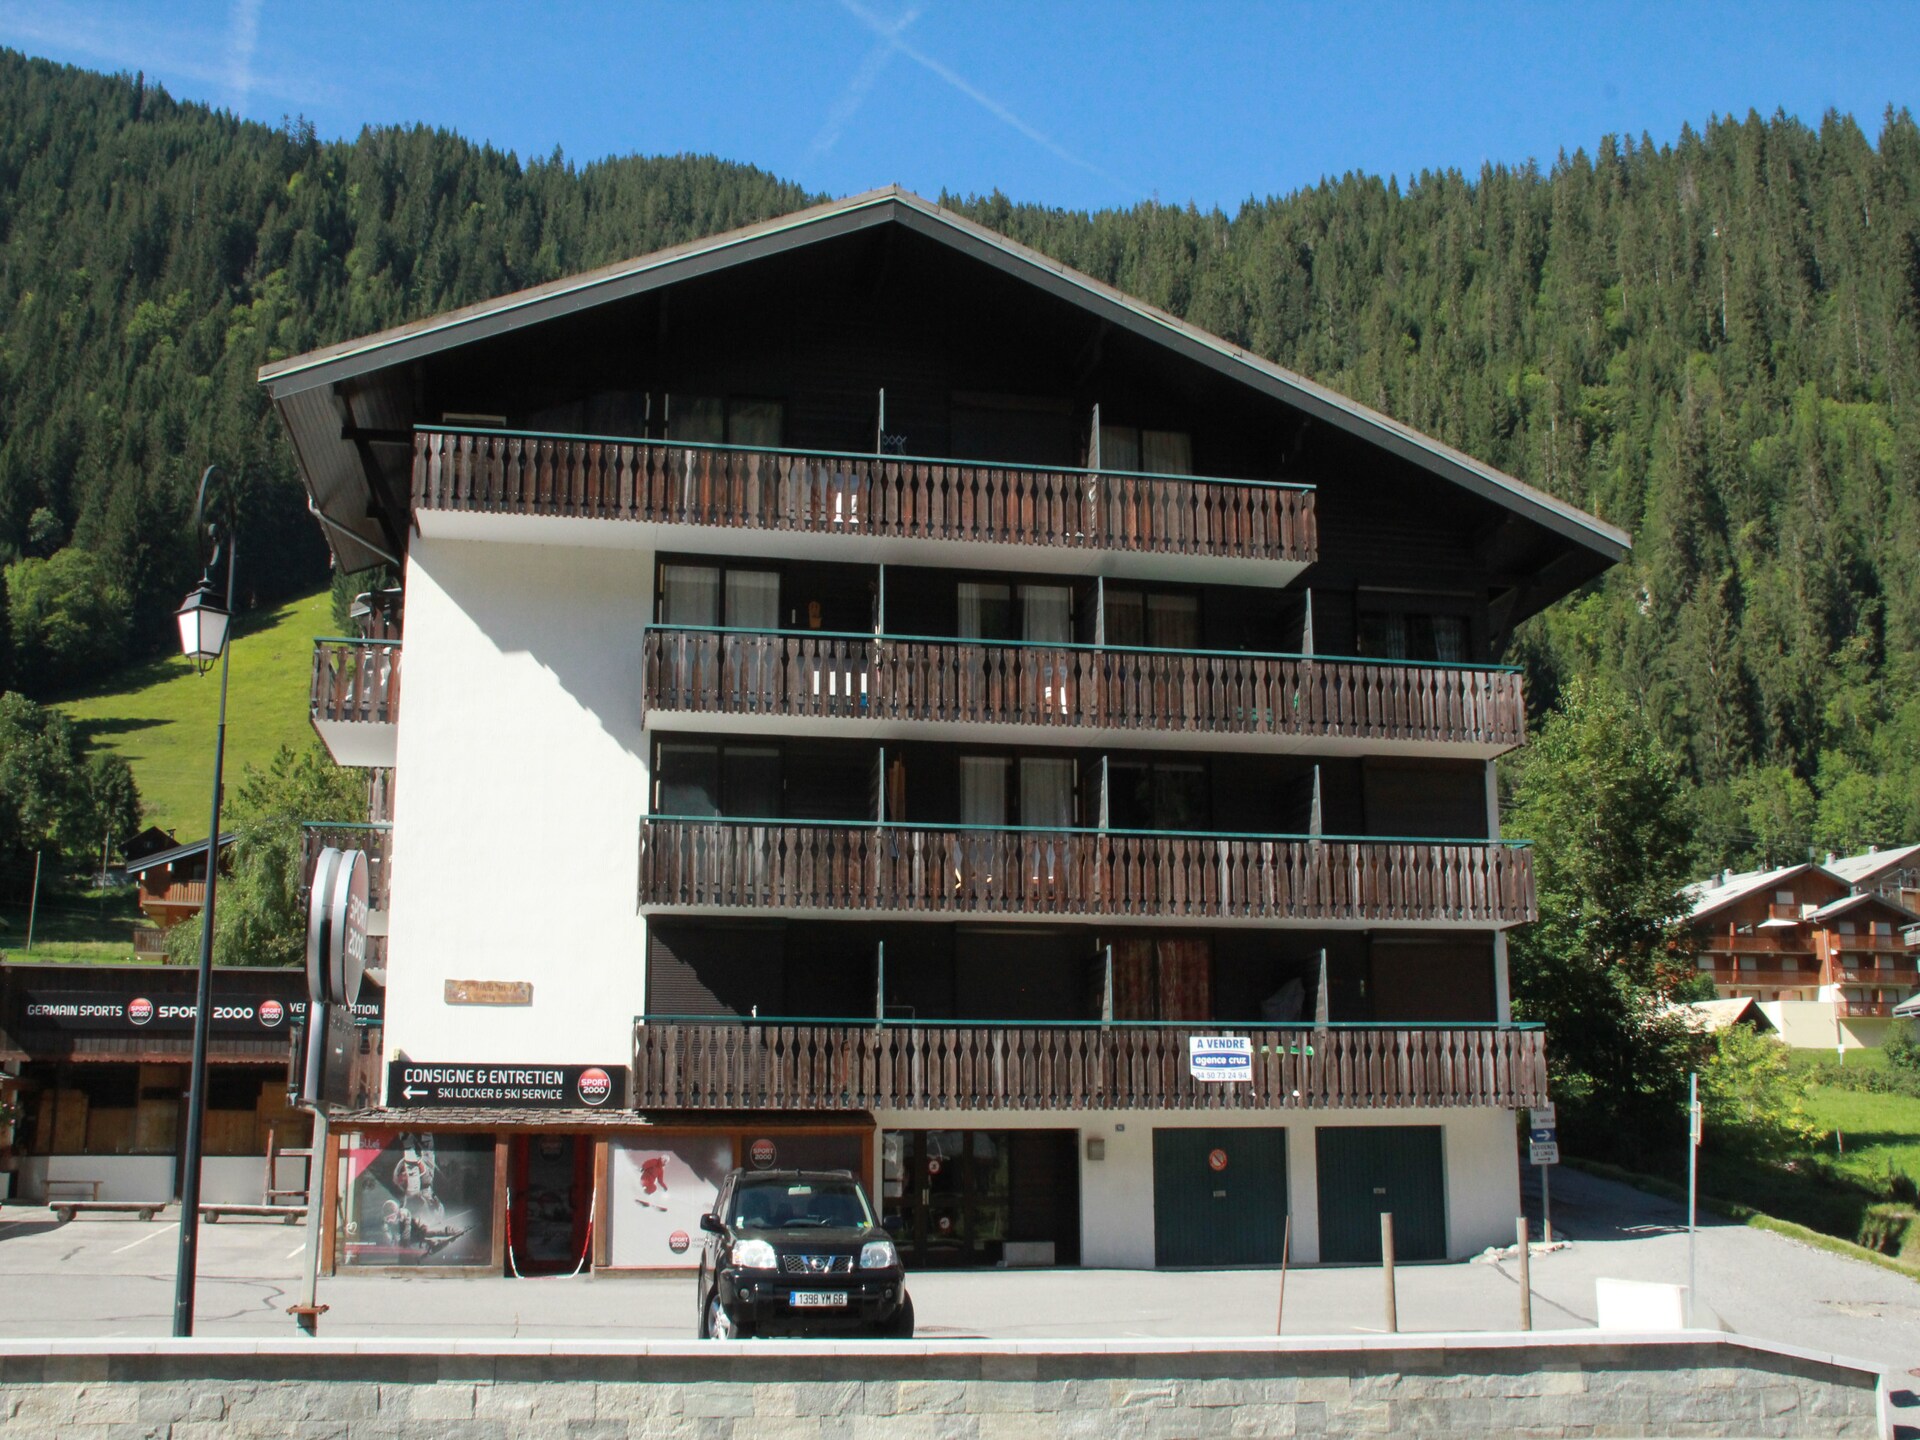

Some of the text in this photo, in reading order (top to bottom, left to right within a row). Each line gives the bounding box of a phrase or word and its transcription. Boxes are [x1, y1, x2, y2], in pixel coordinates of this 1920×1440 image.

[348, 928, 364, 960] 2000
[27, 1004, 123, 1016] GERMAIN SPORTS
[158, 1006, 254, 1018] SPOR 2000
[1197, 1039, 1245, 1048] A VENDRE
[1195, 1056, 1247, 1066] agence cruz
[404, 1068, 564, 1084] CONSIGNE & ENTRETIEN
[581, 1078, 608, 1086] SPORT
[438, 1088, 562, 1100] SKI LOCKER & SKI SERVICE
[822, 1294, 832, 1304] YM
